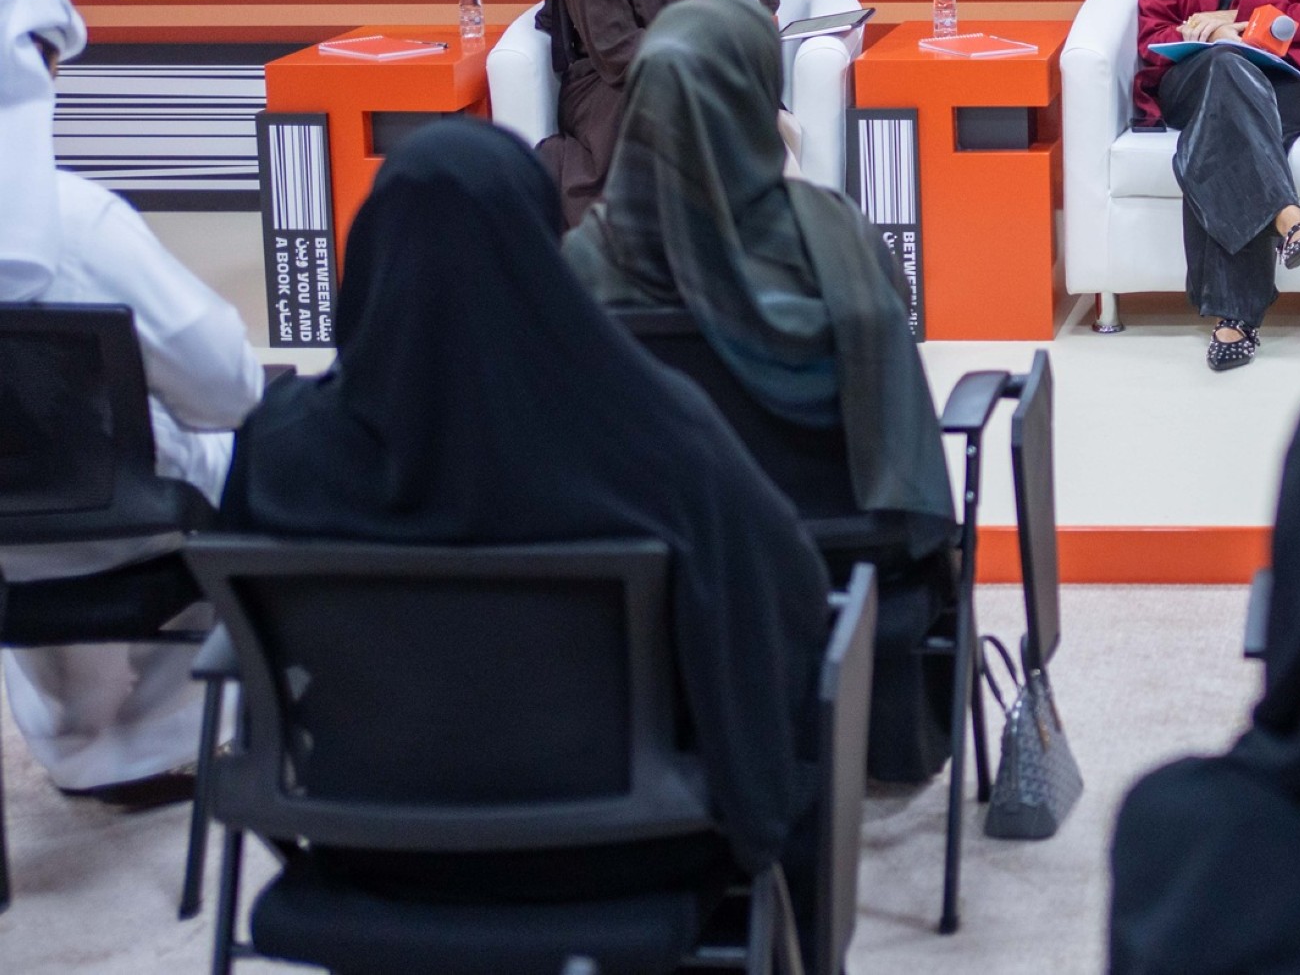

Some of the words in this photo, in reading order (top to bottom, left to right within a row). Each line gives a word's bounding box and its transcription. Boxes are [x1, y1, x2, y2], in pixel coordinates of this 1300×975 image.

[275, 236, 288, 248] A
[276, 252, 291, 295] BOOK
[297, 272, 311, 304] YOU
[315, 237, 331, 312] BETWEEN
[298, 308, 312, 342] AND
